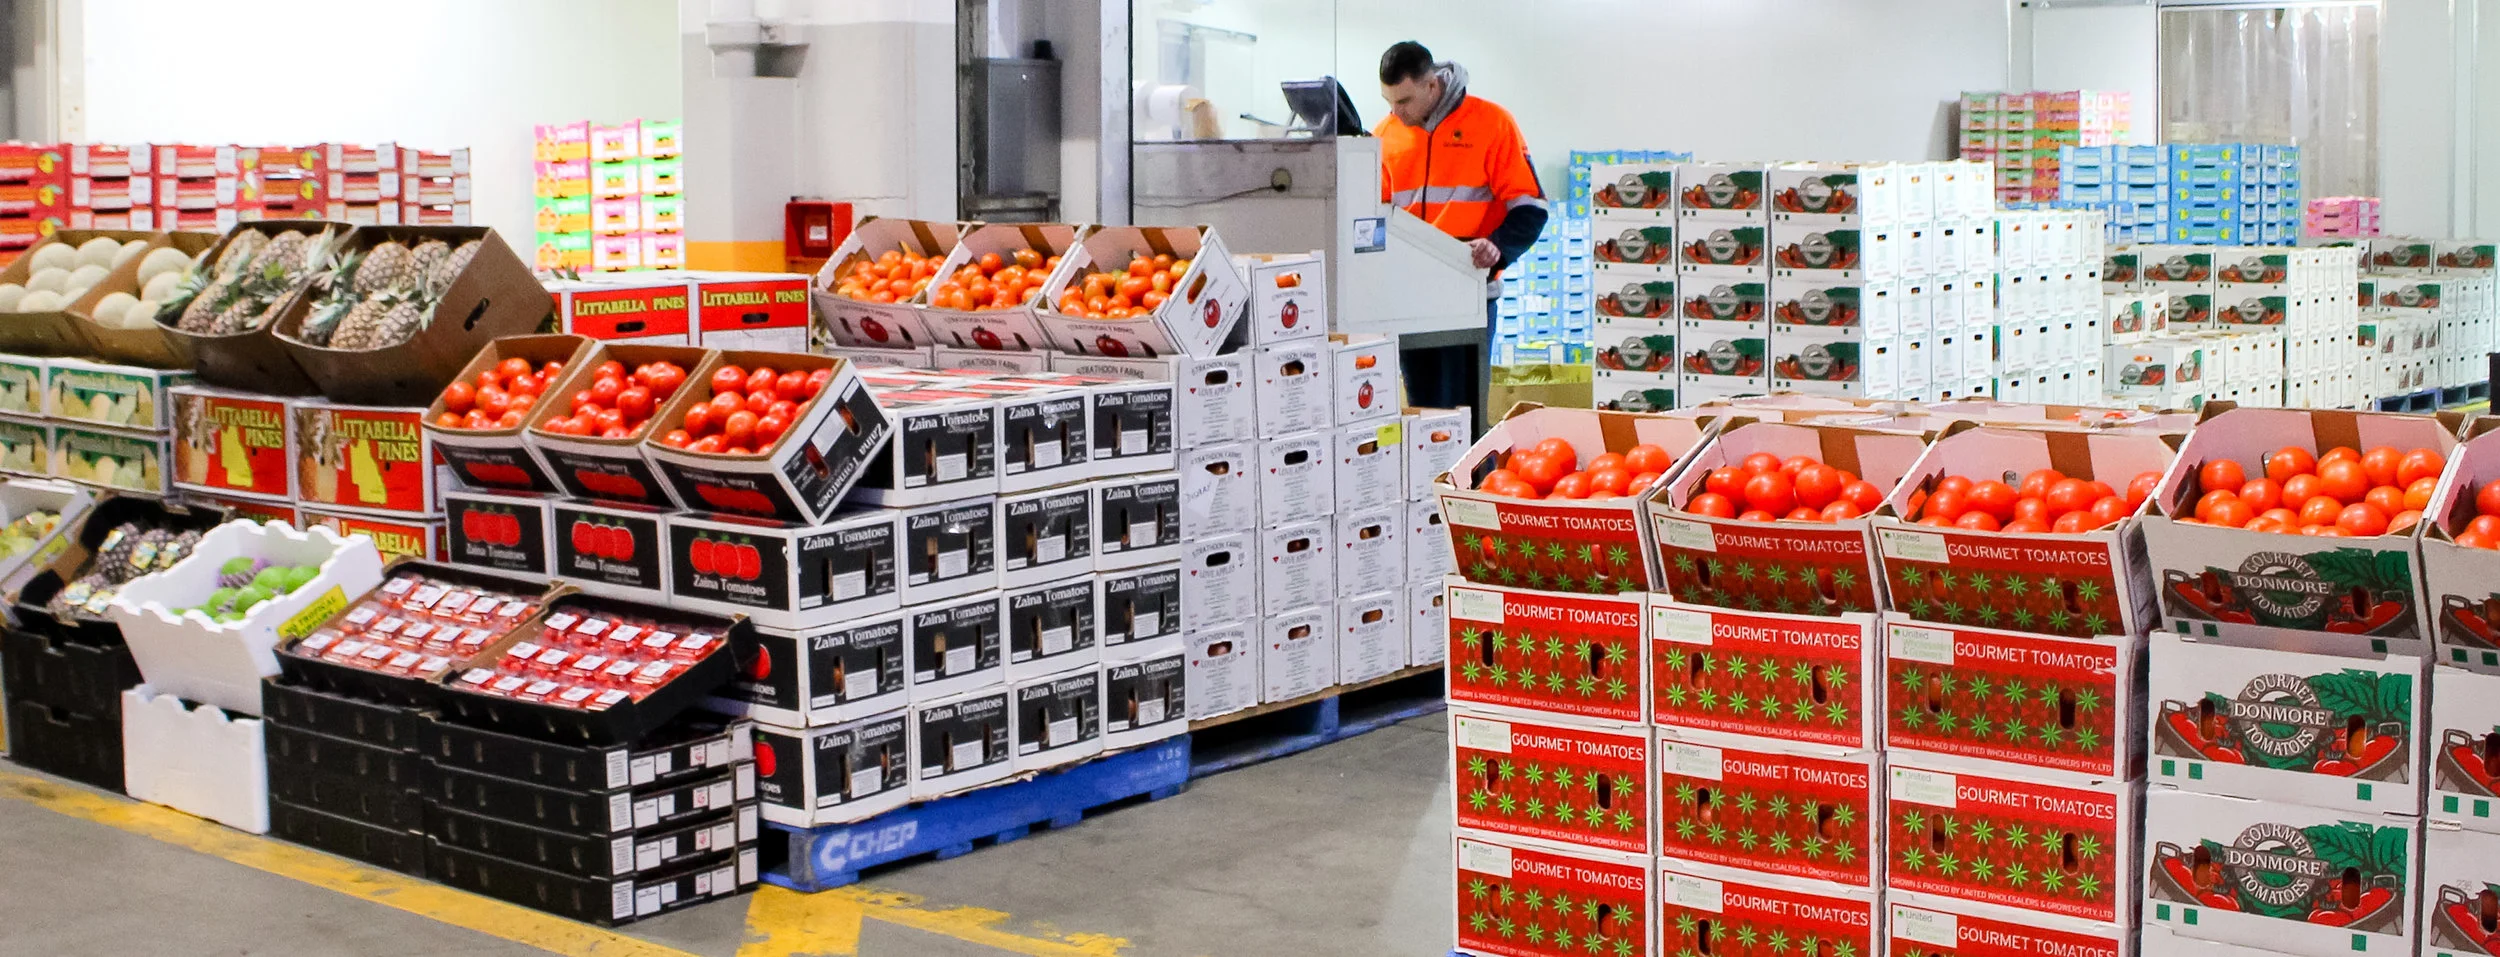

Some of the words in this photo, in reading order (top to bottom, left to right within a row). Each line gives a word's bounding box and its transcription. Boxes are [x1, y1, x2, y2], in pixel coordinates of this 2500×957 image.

[653, 295, 685, 310] PINES
[775, 289, 805, 303] PINES
[1098, 394, 1123, 407] Zaina
[1126, 391, 1168, 404] Tomatoes
[909, 415, 938, 431] Zaina
[1009, 407, 1035, 420] Zaina
[246, 429, 283, 448] PINES
[859, 422, 883, 456] Zaina
[378, 441, 419, 462] PINES
[816, 457, 861, 509] Tomatoes
[1106, 487, 1132, 500] Zaina
[1132, 482, 1175, 496] Tomatoes
[911, 513, 939, 529] Zaina
[941, 506, 989, 524] Tomatoes
[1011, 502, 1038, 516] Zaina
[1039, 494, 1085, 510] Tomatoes
[1499, 512, 1559, 529] GOURMET
[1562, 517, 1634, 531] TOMATOES
[803, 535, 834, 551] Zaina
[837, 526, 889, 543] Tomatoes
[1714, 533, 1779, 550] GOURMET
[1784, 538, 1863, 554] TOMATOES
[574, 555, 597, 570] Zaina
[598, 558, 640, 576] Tomatoes
[1948, 543, 2019, 560] GOURMET
[2023, 548, 2108, 565] TOMATOES
[2244, 552, 2317, 580] GOURMET
[693, 574, 718, 589] Zaina
[720, 578, 766, 596] Tomatoes
[1110, 579, 1135, 592] Zaina
[1136, 573, 1177, 587] Tomatoes
[2237, 575, 2329, 594] DONMORE
[1015, 595, 1042, 609] Zaina
[1044, 584, 1089, 601] Tomatoes
[2252, 592, 2321, 618] TOMATOES
[919, 612, 946, 628] Zaina
[949, 602, 996, 619] Tomatoes
[1505, 603, 1563, 620] GOURMET
[1567, 609, 1638, 627] TOMATOES
[814, 635, 845, 650] Zaina
[847, 623, 899, 643] Tomatoes
[1713, 623, 1778, 642] GOURMET
[1782, 630, 1859, 649] TOMATOES
[1902, 629, 1928, 640] United
[1955, 642, 2025, 663] GOURMET
[2029, 650, 2114, 671] TOMATOES
[1112, 667, 1139, 681] Zaina
[1140, 658, 1182, 673] Tomatoes
[1022, 687, 1049, 701] Zaina
[1050, 676, 1094, 693] Tomatoes
[2246, 674, 2317, 706] GOURMET
[925, 707, 953, 723] Zaina
[955, 697, 1003, 714] Tomatoes
[2234, 703, 2326, 726] DONMORE
[819, 735, 850, 750] Zaina
[852, 721, 902, 739] Tomatoes
[1720, 720, 1744, 730] UNITED
[1745, 723, 1792, 736] WHOLESALERS
[2245, 724, 2315, 756] TOMATOES
[1512, 733, 1572, 752] GOURMET
[1576, 741, 1644, 761] TOMATOES
[1890, 736, 1914, 747] GROWN
[1922, 740, 1948, 751] PACKED
[1959, 745, 1985, 756] UNITED
[1986, 748, 2037, 763] WHOLESALERS
[2045, 756, 2080, 768] GROWERS
[2098, 763, 2111, 772] LTD
[1723, 759, 1788, 779] GOURMET
[1793, 768, 1867, 788] TOMATOES
[1957, 785, 2029, 808] GOURMET
[2033, 796, 2114, 819] TOMATOES
[850, 820, 918, 861] CHEP
[2241, 824, 2312, 856] GOURMET
[1513, 858, 1572, 878] GOURMET
[1575, 868, 1644, 890] TOMATOES
[2229, 850, 2321, 876] DONMORE
[1891, 877, 1915, 889] GROWN
[1923, 882, 1949, 894] PACKED
[1951, 886, 1959, 895] BY
[1961, 888, 1986, 899] UNITED
[1988, 892, 2039, 907] WHOLESALERS
[2047, 901, 2081, 914] GROWERS
[2100, 909, 2113, 919] LTD
[2241, 872, 2309, 904] TOMATOES
[1723, 892, 1789, 914] GOURMET
[1793, 903, 1869, 926] TOMATOES
[1905, 909, 1932, 922] United
[1958, 926, 2030, 950] GOURMET
